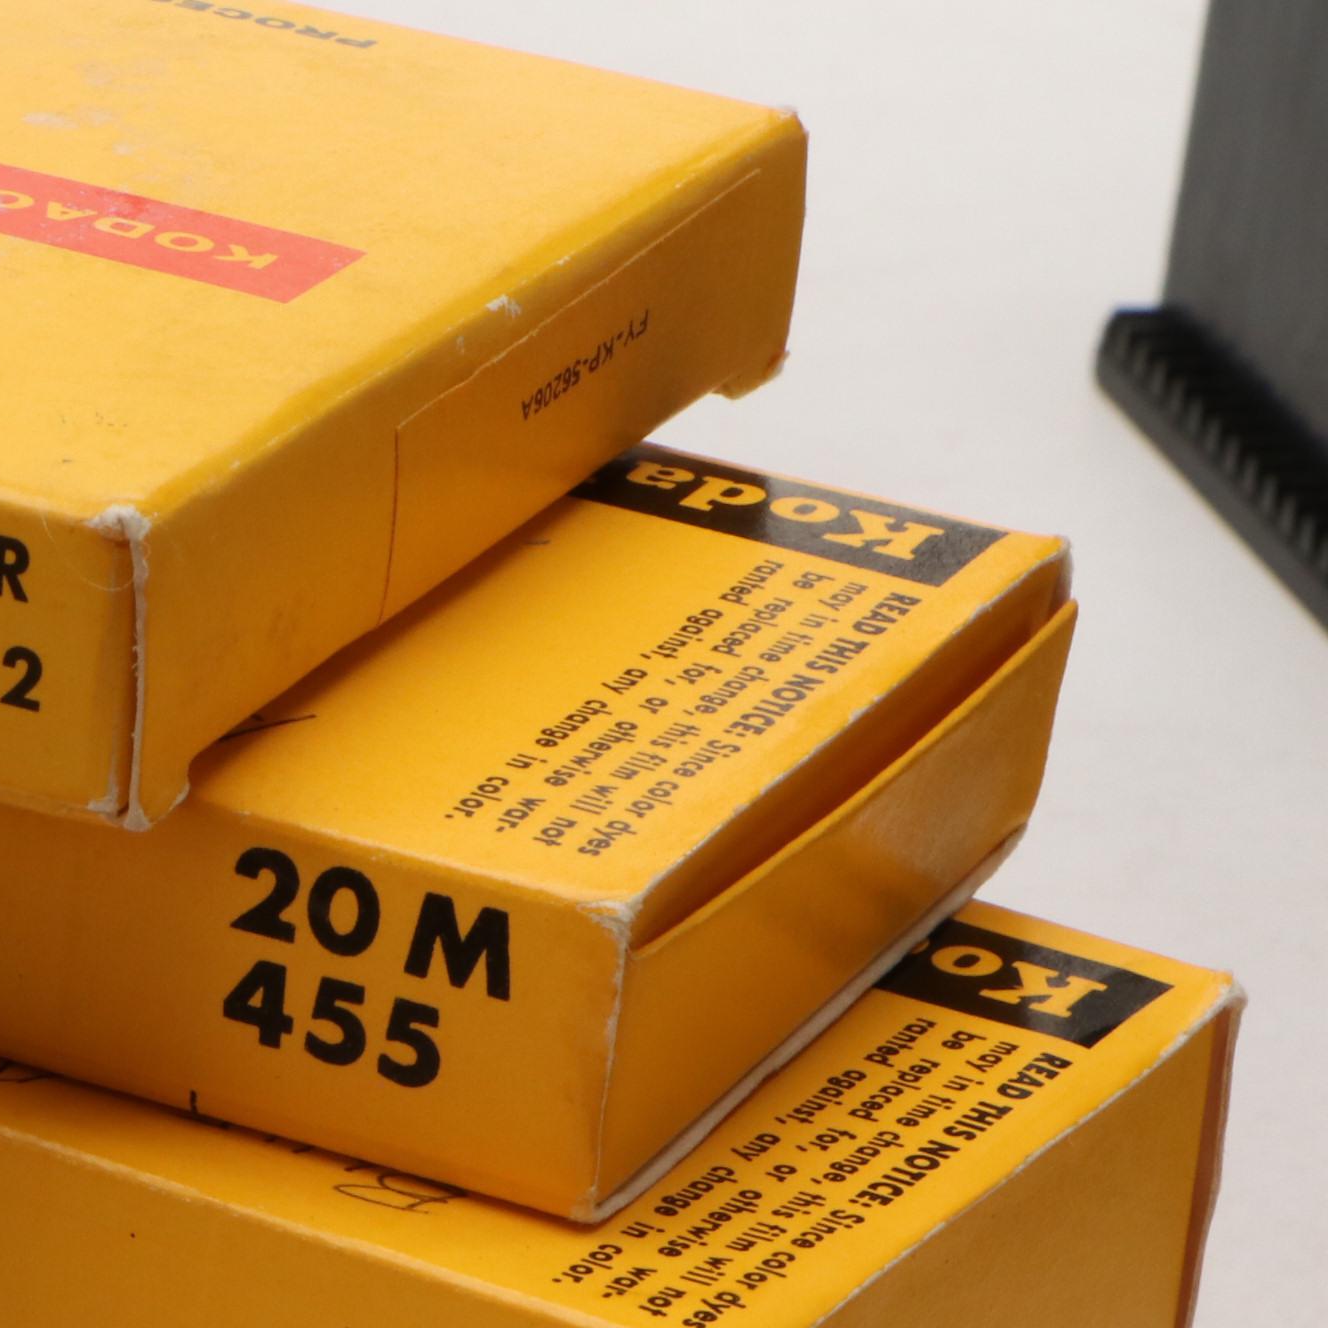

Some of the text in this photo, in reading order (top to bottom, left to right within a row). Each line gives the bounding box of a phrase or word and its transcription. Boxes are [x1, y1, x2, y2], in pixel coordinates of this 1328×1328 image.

[626, 461, 945, 561] Koda
[445, 560, 784, 819] ranted against, any change in color.
[496, 571, 835, 832] be replaced for, or otherwise war-
[533, 582, 868, 847] may in time change, this film will not
[578, 593, 923, 856] READ THIS NOTICE: Since color dyes
[222, 959, 442, 1088] 455
[229, 845, 511, 1002] 20 M
[552, 1017, 937, 1283] ranted against, any change in color.
[601, 1029, 987, 1299] be replaced for, or otherwise war-
[639, 1041, 1019, 1317] may in time change, this film will not
[682, 1052, 1073, 1328] READ THIS NOTICE: Since color dyes
